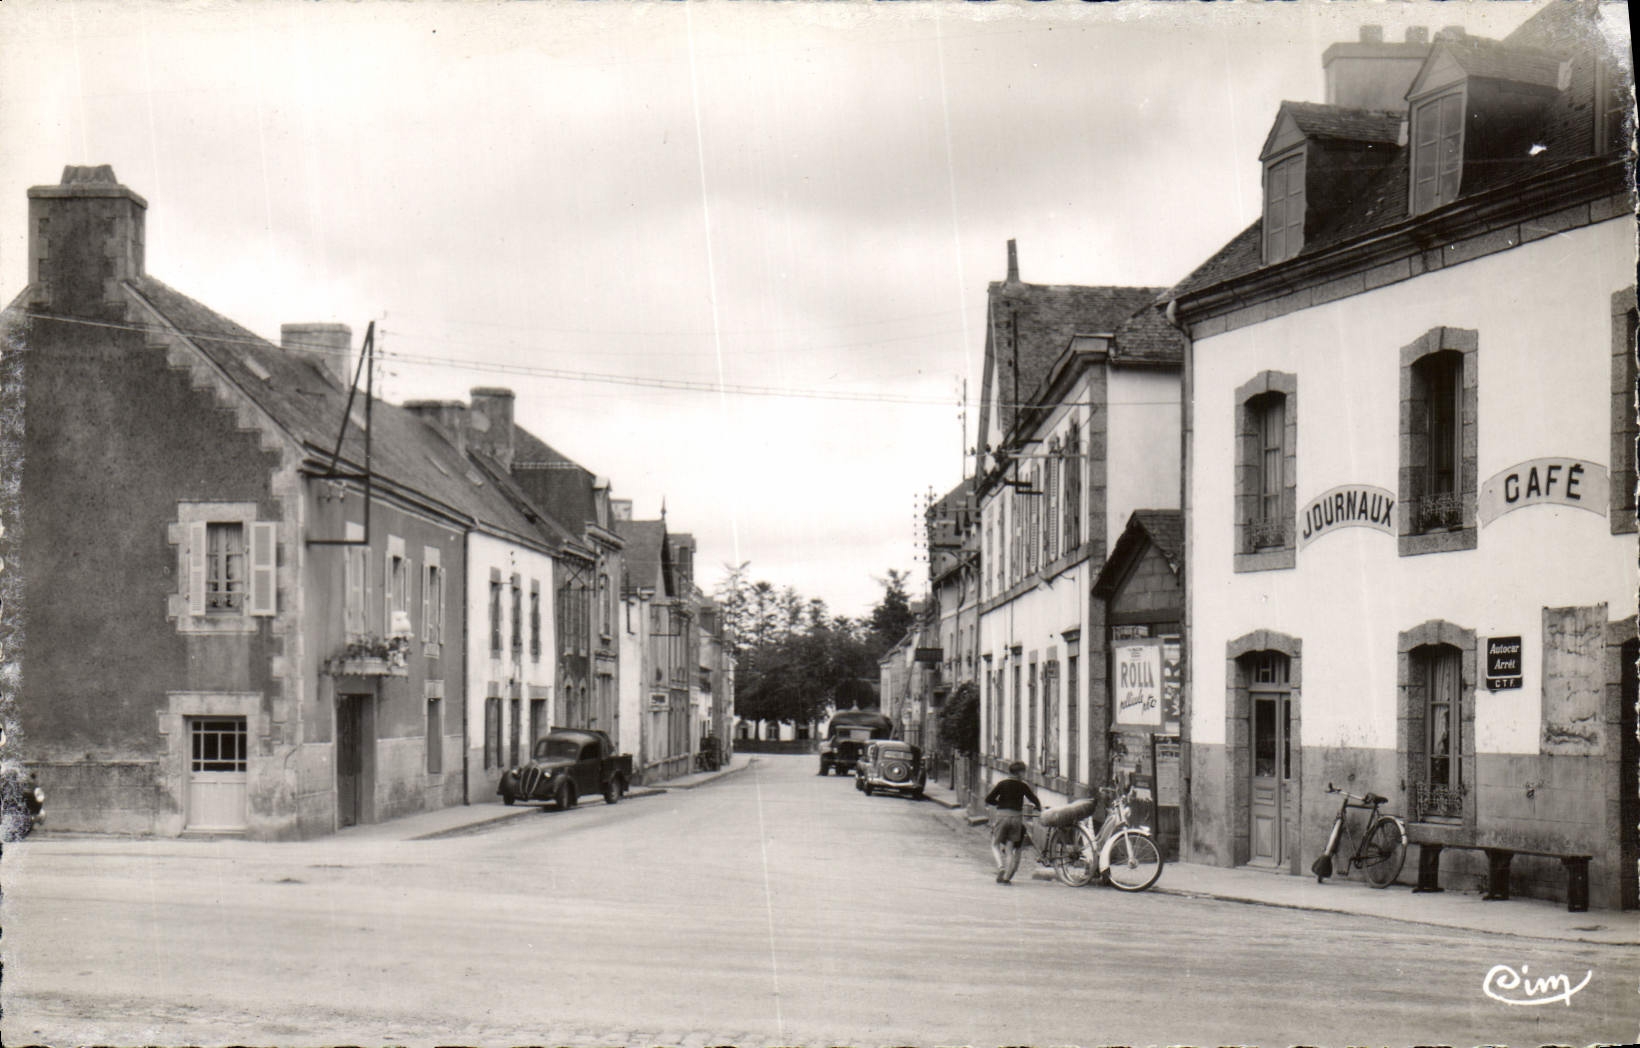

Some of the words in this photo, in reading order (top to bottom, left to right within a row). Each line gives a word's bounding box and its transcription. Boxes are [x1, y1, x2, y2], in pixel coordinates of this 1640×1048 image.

[1504, 463, 1584, 503] CAFÉ
[1303, 490, 1395, 538] JOURNAUX
[1490, 642, 1520, 654] Autocar
